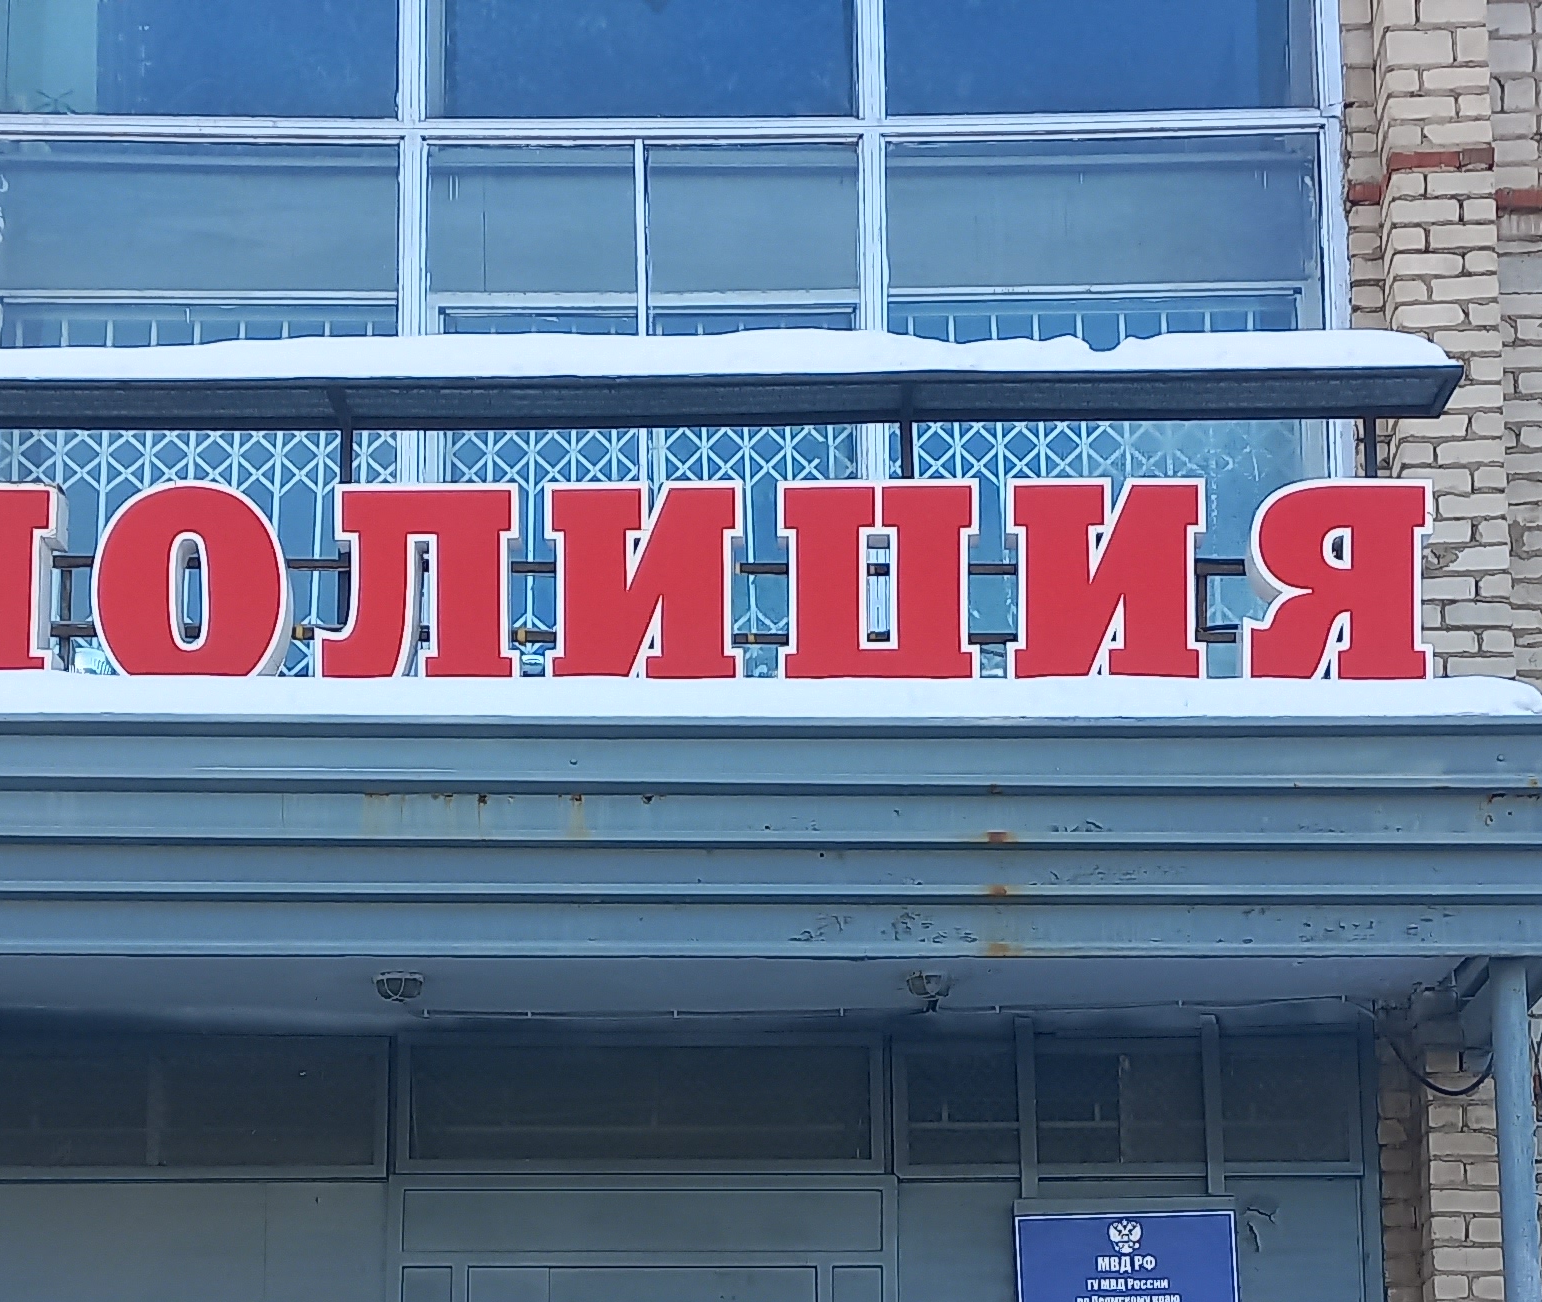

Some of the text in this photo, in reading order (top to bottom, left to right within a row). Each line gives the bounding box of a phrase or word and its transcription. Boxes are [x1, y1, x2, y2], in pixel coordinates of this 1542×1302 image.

[1097, 1255, 1157, 1274] МВД РФ
[1087, 1278, 1169, 1291] ГУ МВД России
